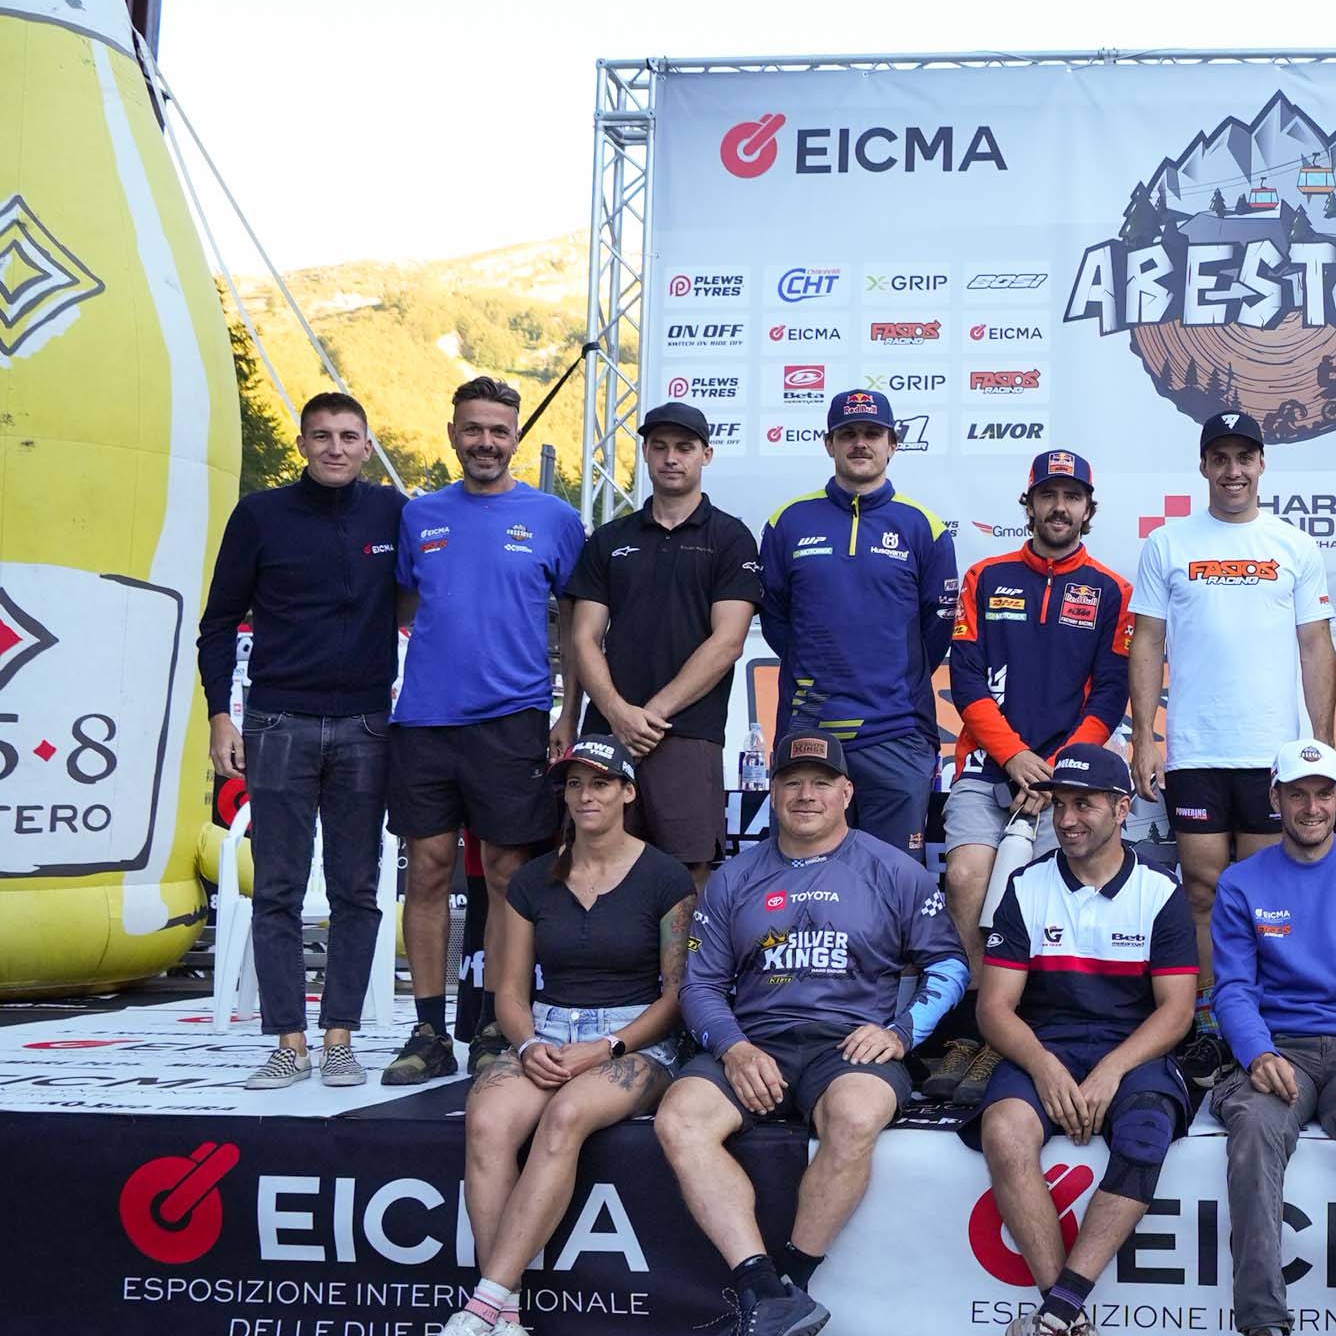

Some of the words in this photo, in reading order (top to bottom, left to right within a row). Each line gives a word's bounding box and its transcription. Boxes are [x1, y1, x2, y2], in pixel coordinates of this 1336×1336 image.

[795, 124, 1009, 174] EICMA
[694, 275, 743, 285] PLEWS
[866, 275, 948, 291] X-GRIP
[693, 286, 741, 297] TYRES
[668, 324, 699, 339] ON
[703, 324, 744, 338] OFF
[788, 328, 841, 341] EICMA
[989, 327, 1043, 340] EICMA
[884, 337, 925, 346] RACING
[692, 377, 739, 387] PLEWS
[864, 374, 946, 391] X-GRIP
[691, 388, 737, 398] TYRES
[983, 386, 1024, 394] RACING
[786, 430, 826, 442] EICM
[967, 422, 1044, 440] LAVOR
[797, 536, 827, 546] WP
[1189, 559, 1280, 580] FASTOS
[1206, 575, 1260, 586] RACING
[995, 586, 1024, 596] WP
[790, 890, 840, 903] TOYOTA
[1263, 909, 1291, 920] EICMA
[788, 930, 849, 949] SILVER
[762, 943, 849, 971] KINGS
[123, 1277, 347, 1306] ESPOSIZIONE
